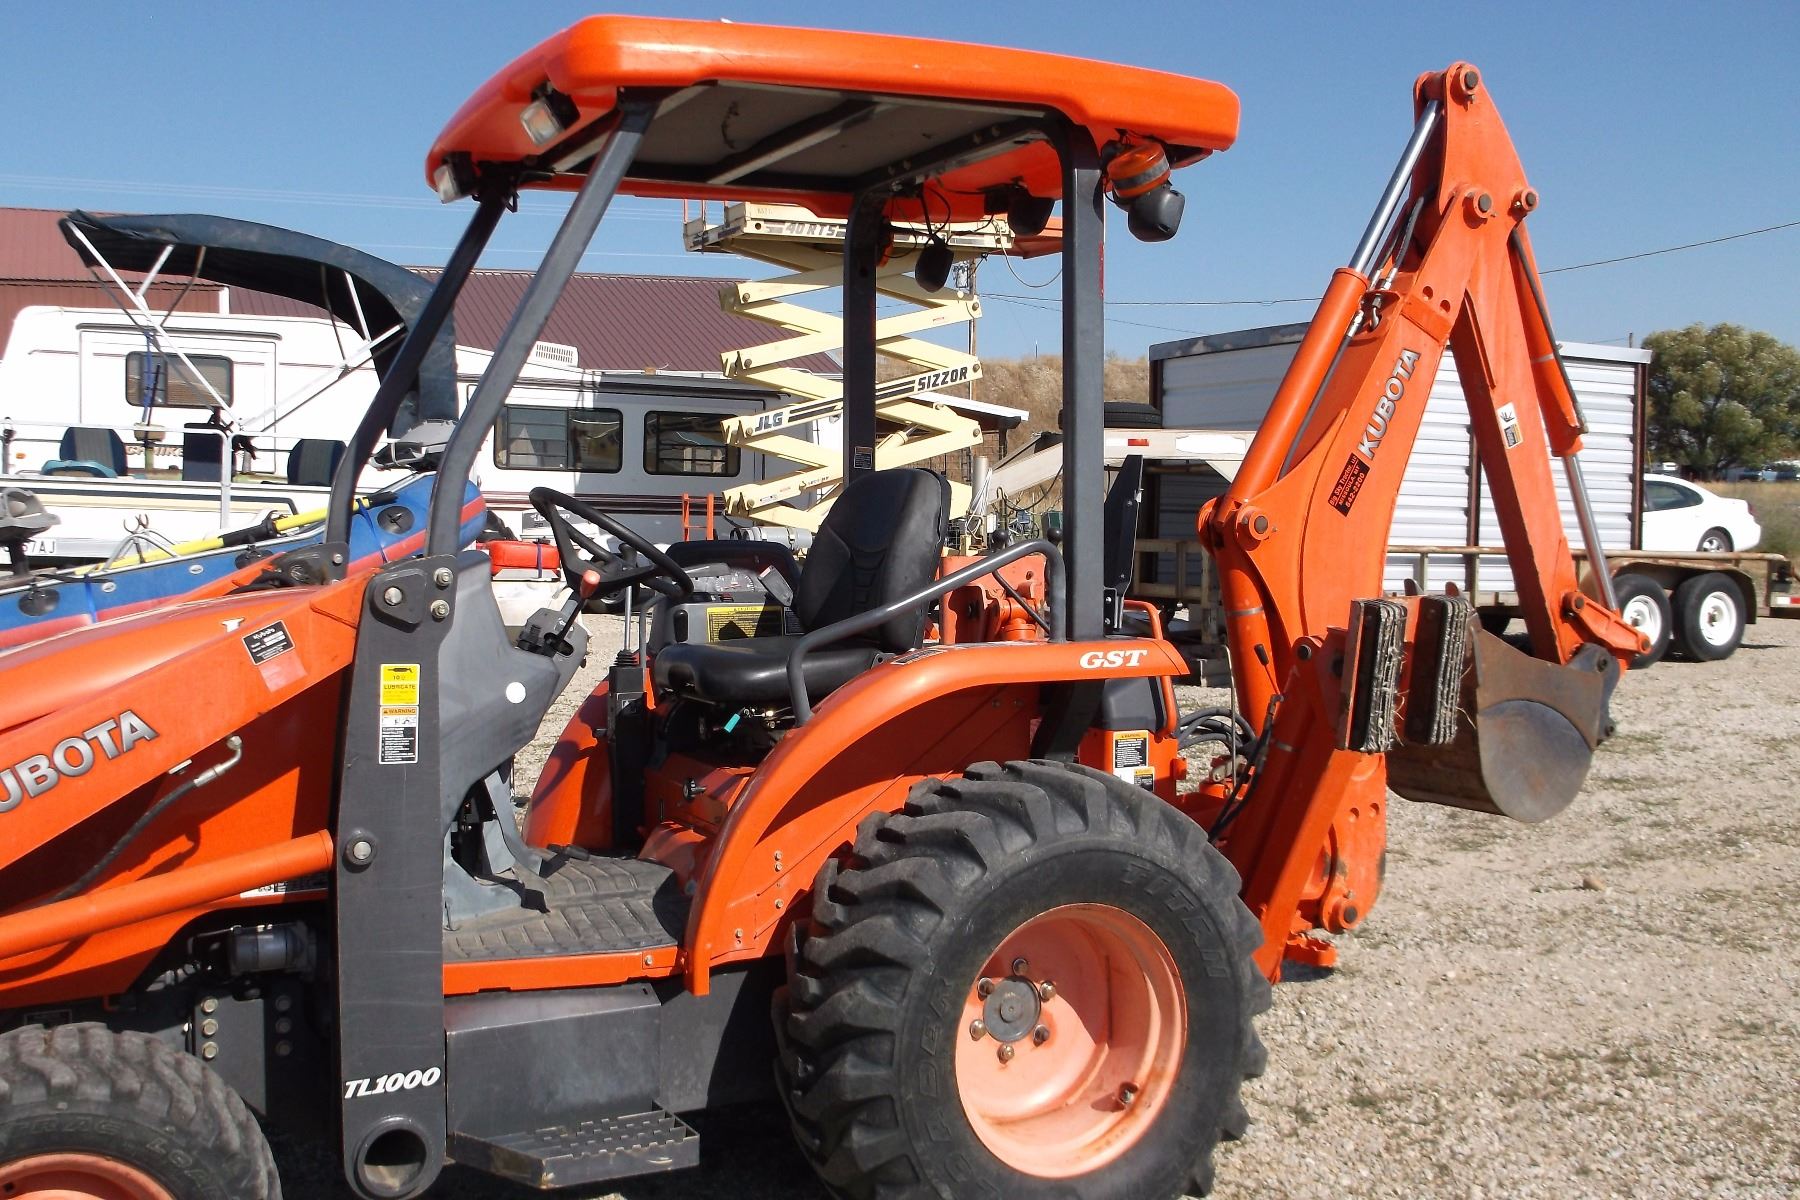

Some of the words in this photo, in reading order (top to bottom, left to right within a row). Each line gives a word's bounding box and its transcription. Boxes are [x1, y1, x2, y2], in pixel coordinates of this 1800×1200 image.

[785, 222, 806, 234] 40
[917, 366, 968, 391] SIZZOR
[1357, 349, 1421, 460] KUBOTA
[755, 412, 783, 431] JLG
[1334, 484, 1343, 496] Sky
[1079, 649, 1149, 669] GST
[344, 1066, 441, 1099] TL1000
